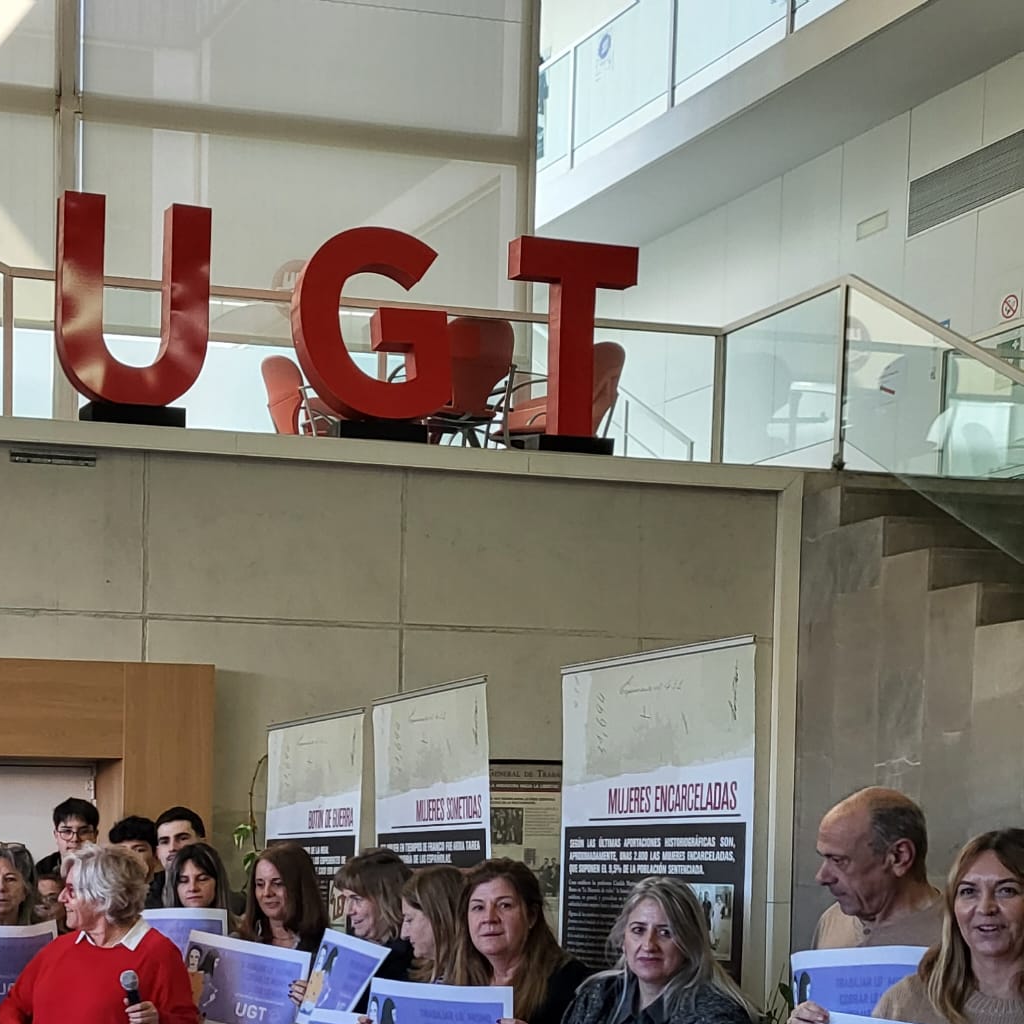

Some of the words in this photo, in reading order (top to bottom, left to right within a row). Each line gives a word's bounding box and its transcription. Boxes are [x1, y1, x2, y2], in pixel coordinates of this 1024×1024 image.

[56, 190, 639, 437] UGT
[416, 798, 444, 822] MUJERES
[447, 794, 482, 820] SOMETIDAS
[608, 785, 652, 814] MUJERES
[654, 781, 737, 813] ENCARCELADAS
[324, 808, 332, 828] DE
[235, 1001, 268, 1021] UGT
